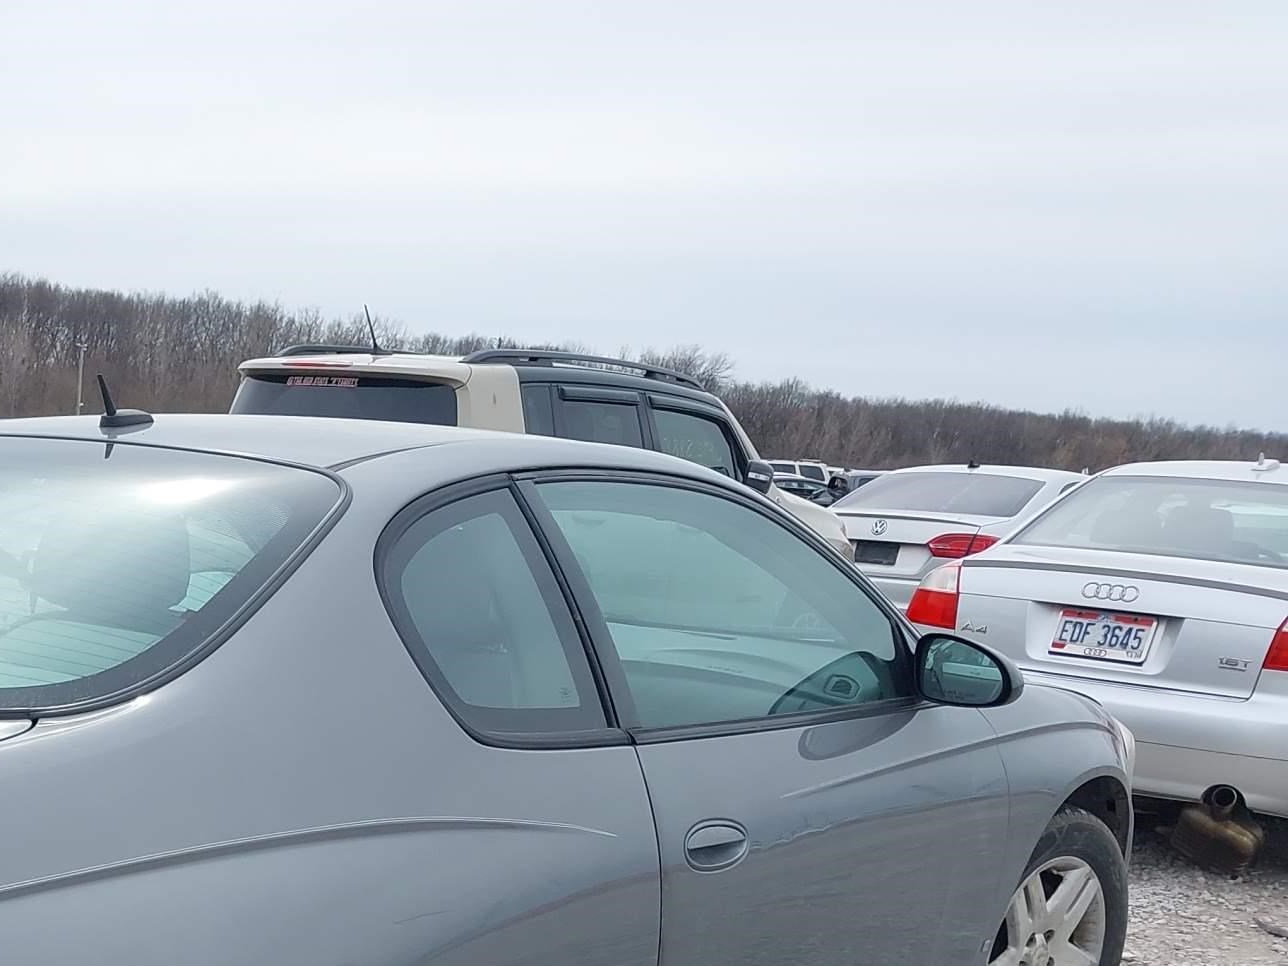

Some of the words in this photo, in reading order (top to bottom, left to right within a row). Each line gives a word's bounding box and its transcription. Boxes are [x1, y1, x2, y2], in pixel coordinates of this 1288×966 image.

[961, 620, 988, 635] A4
[1058, 619, 1097, 644] EDF
[1096, 624, 1146, 651] 3645
